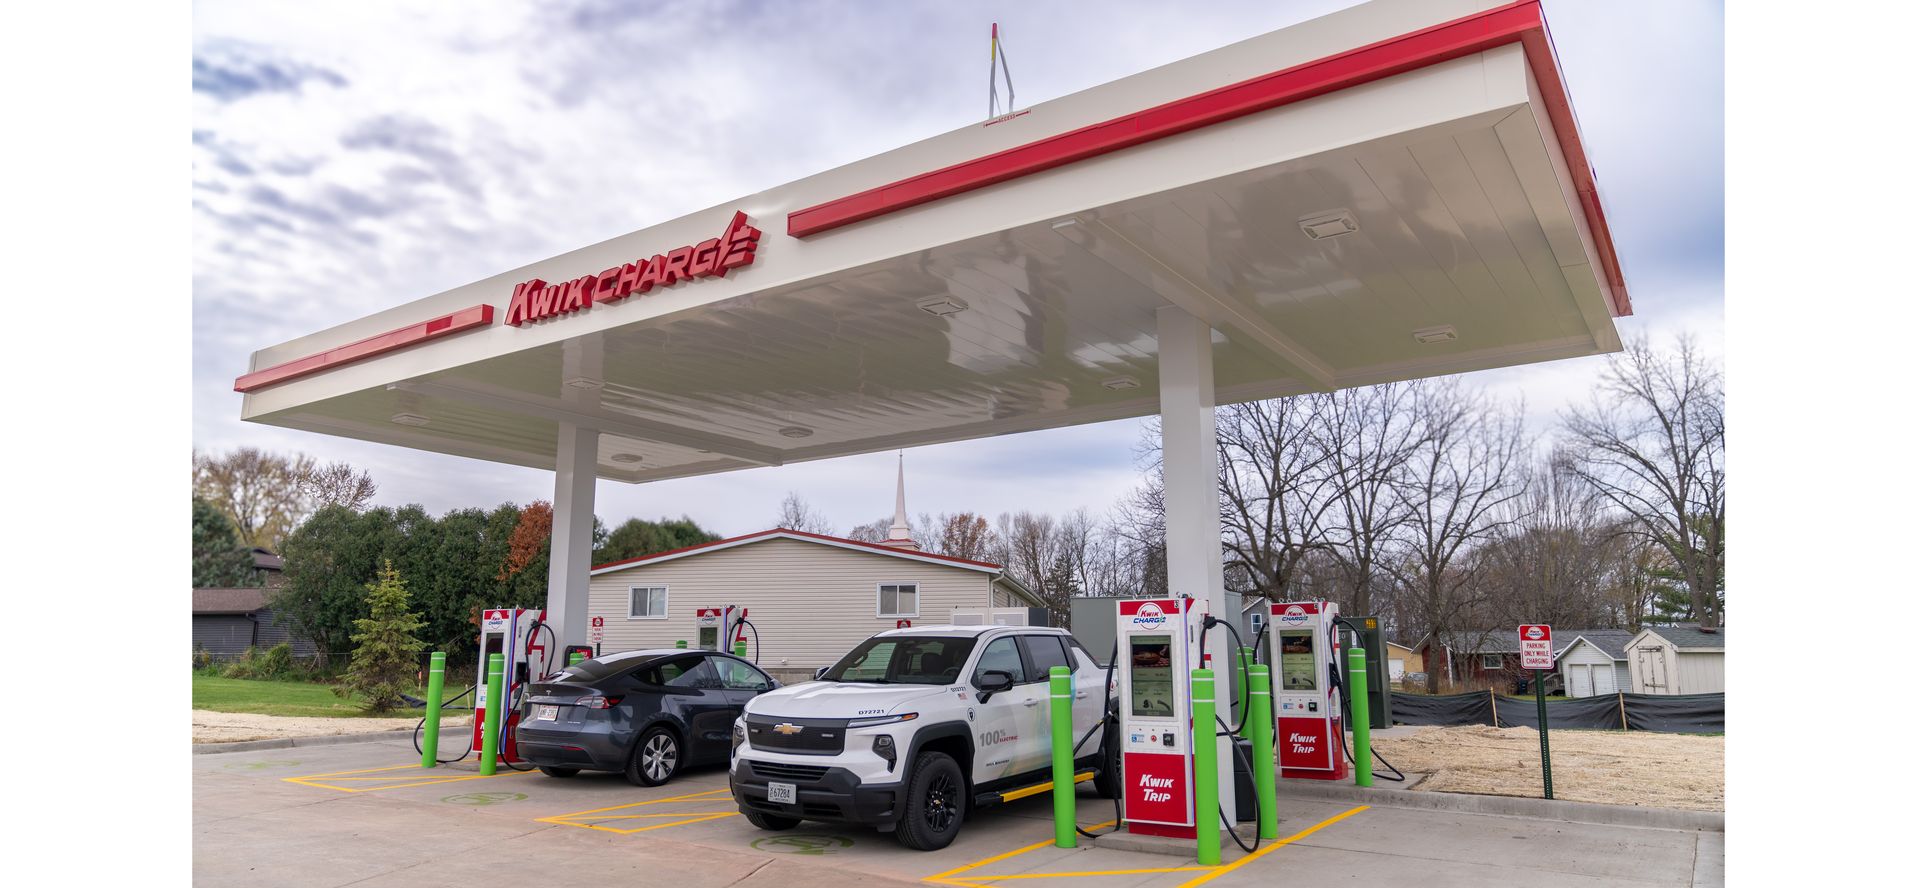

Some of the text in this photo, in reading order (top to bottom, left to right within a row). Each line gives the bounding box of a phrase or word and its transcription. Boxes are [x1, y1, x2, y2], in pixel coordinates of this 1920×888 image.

[504, 210, 762, 327] KWIK CHARGE
[1289, 732, 1317, 743] KWIK
[1292, 743, 1315, 754] TRIP
[1139, 774, 1174, 788] KWIK
[1143, 788, 1171, 802] TRIP
